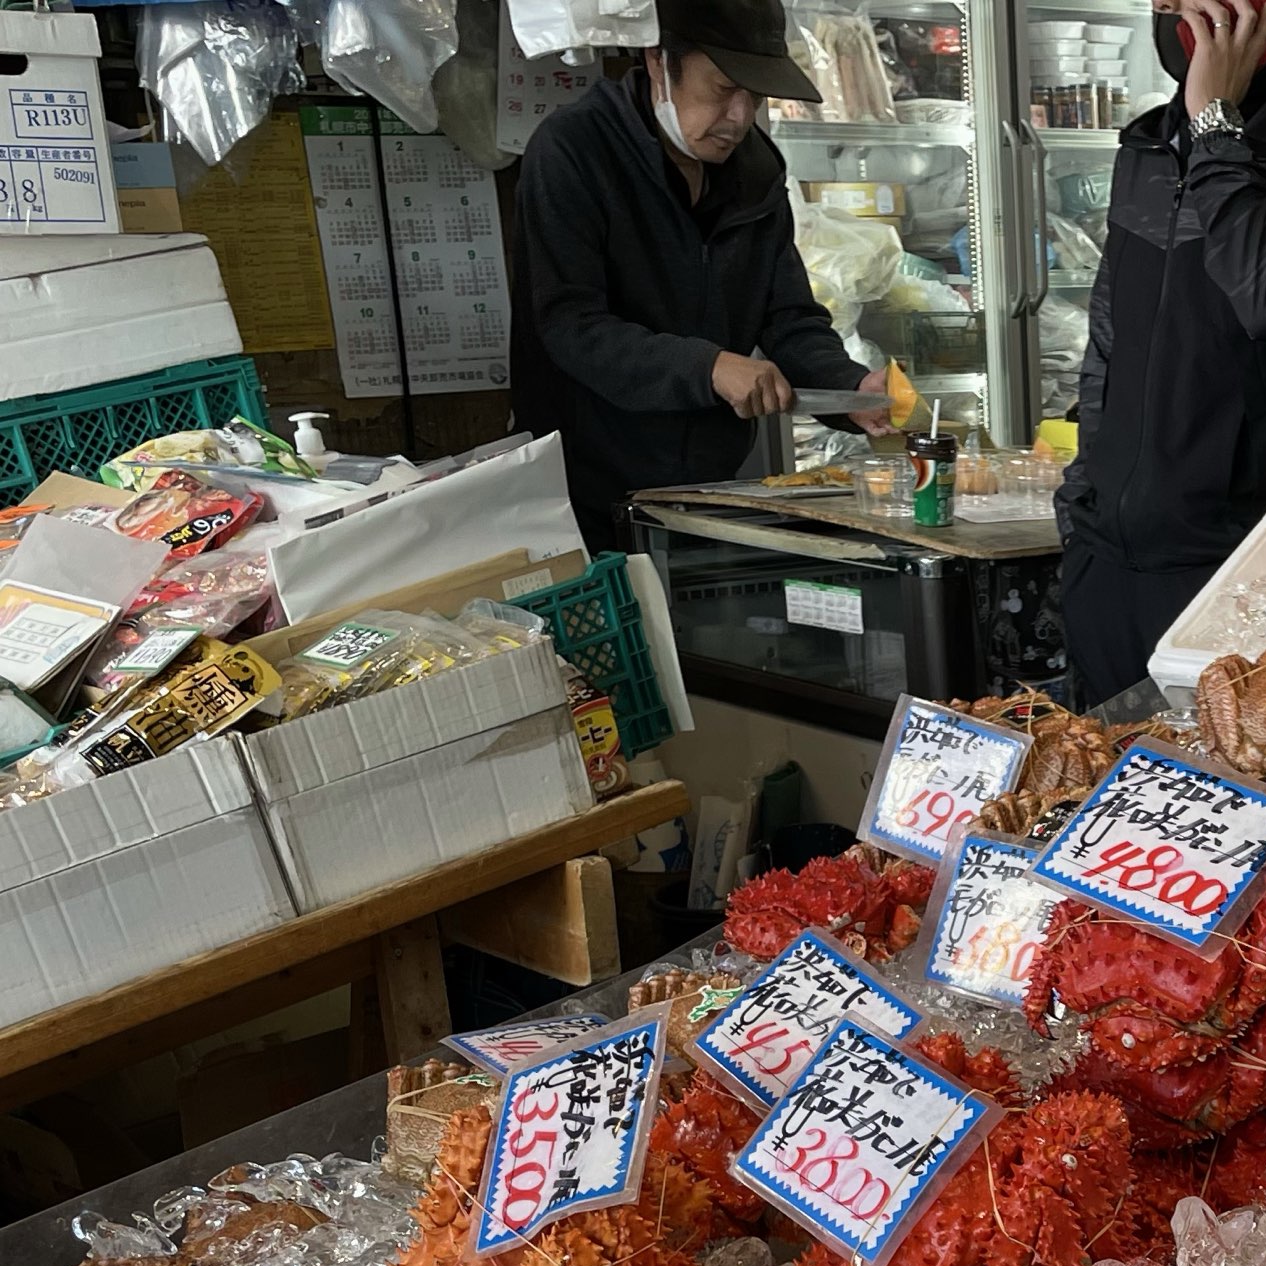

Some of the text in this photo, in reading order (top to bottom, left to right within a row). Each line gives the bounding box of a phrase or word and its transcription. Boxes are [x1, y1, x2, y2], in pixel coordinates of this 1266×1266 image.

[25, 108, 87, 127] R113U
[54, 167, 95, 184] 502091
[22, 179, 37, 203] 8
[360, 303, 486, 318] 10 11 12
